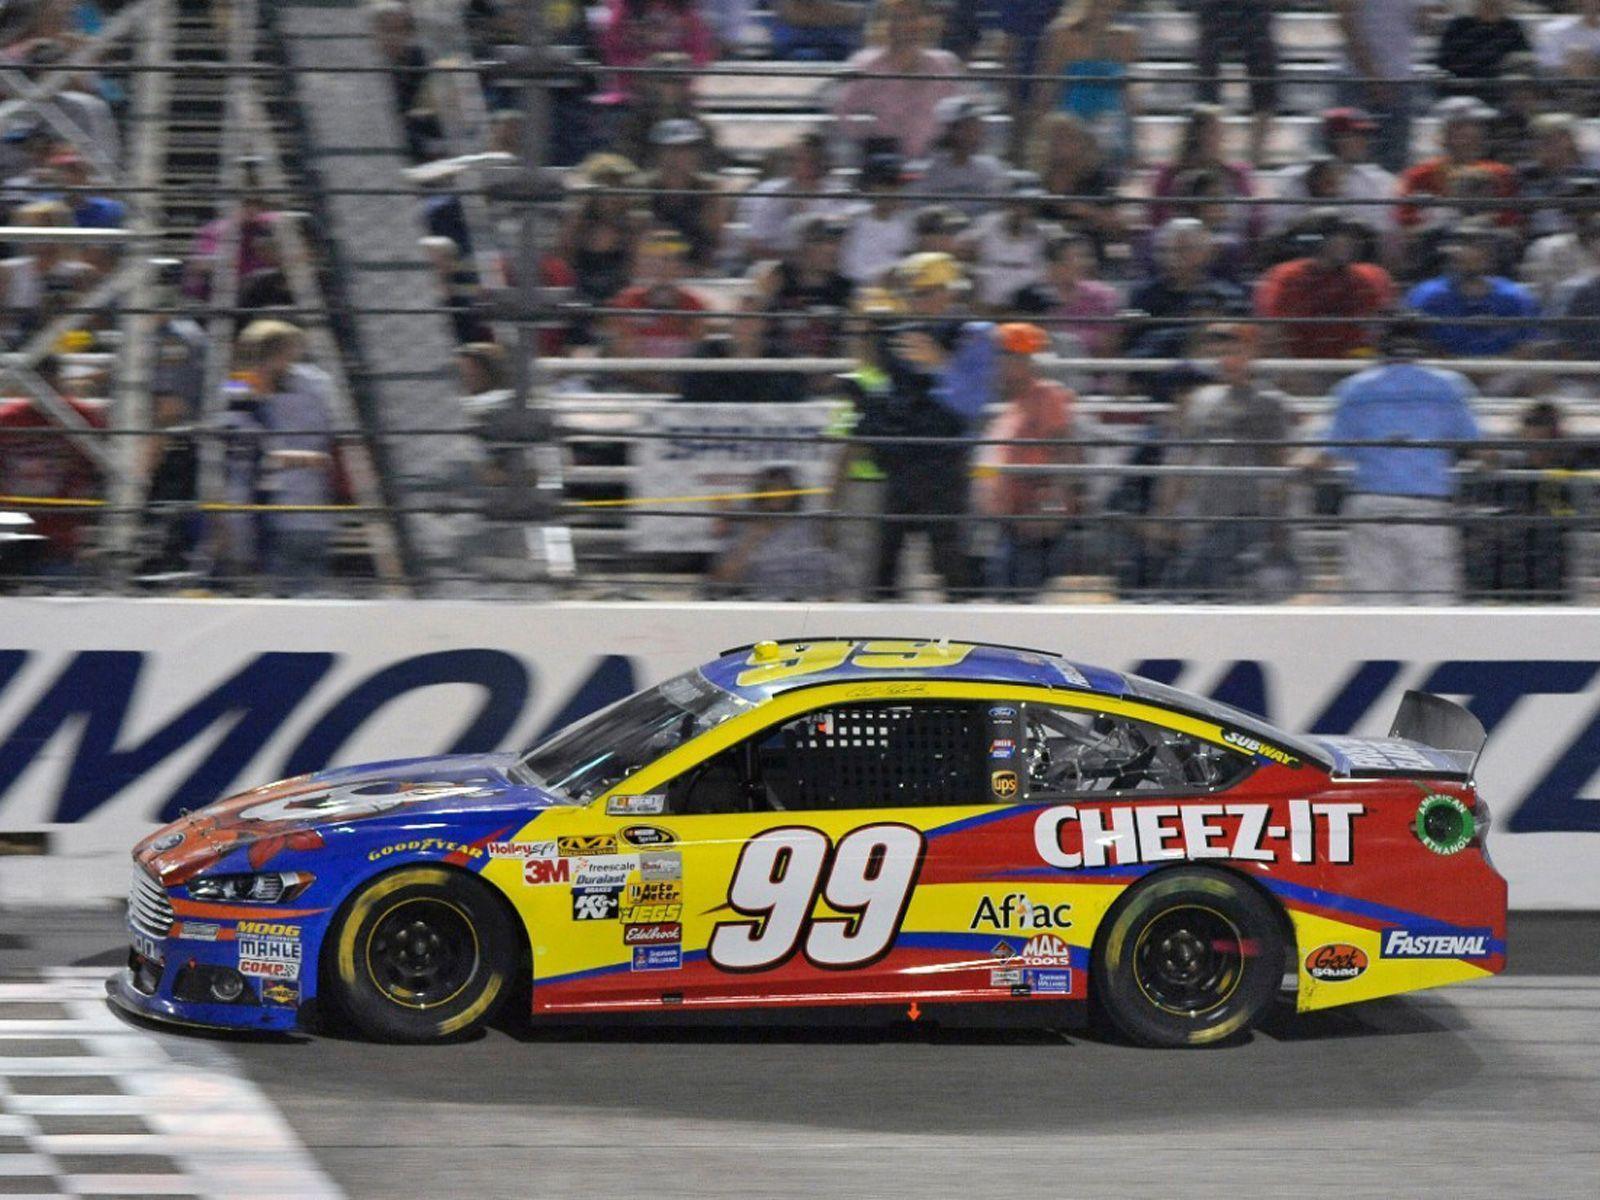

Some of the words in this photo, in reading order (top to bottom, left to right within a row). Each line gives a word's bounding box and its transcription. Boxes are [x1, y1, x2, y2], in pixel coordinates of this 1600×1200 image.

[1225, 732, 1299, 764] SUBWAY
[995, 779, 1016, 794] ups
[1419, 794, 1467, 815] AMERICAN
[1034, 800, 1364, 868] CHEEZ-IT
[368, 838, 484, 861] GOODYEAR
[489, 843, 532, 858] Holley
[1423, 835, 1470, 855] ETHANOL
[525, 859, 569, 884] 3M
[589, 862, 635, 873] freescale
[576, 873, 626, 885] Duralast
[707, 823, 926, 972] 99
[621, 904, 682, 924] JEGS
[238, 921, 301, 937] MOOG
[625, 926, 680, 941] Edelbrock
[241, 941, 301, 958] MAHLE
[1023, 935, 1068, 957] MAC
[1385, 931, 1487, 955] FASTENAL
[1023, 957, 1069, 966] TOOLS
[1315, 945, 1357, 969] Geek
[241, 961, 284, 975] COMP
